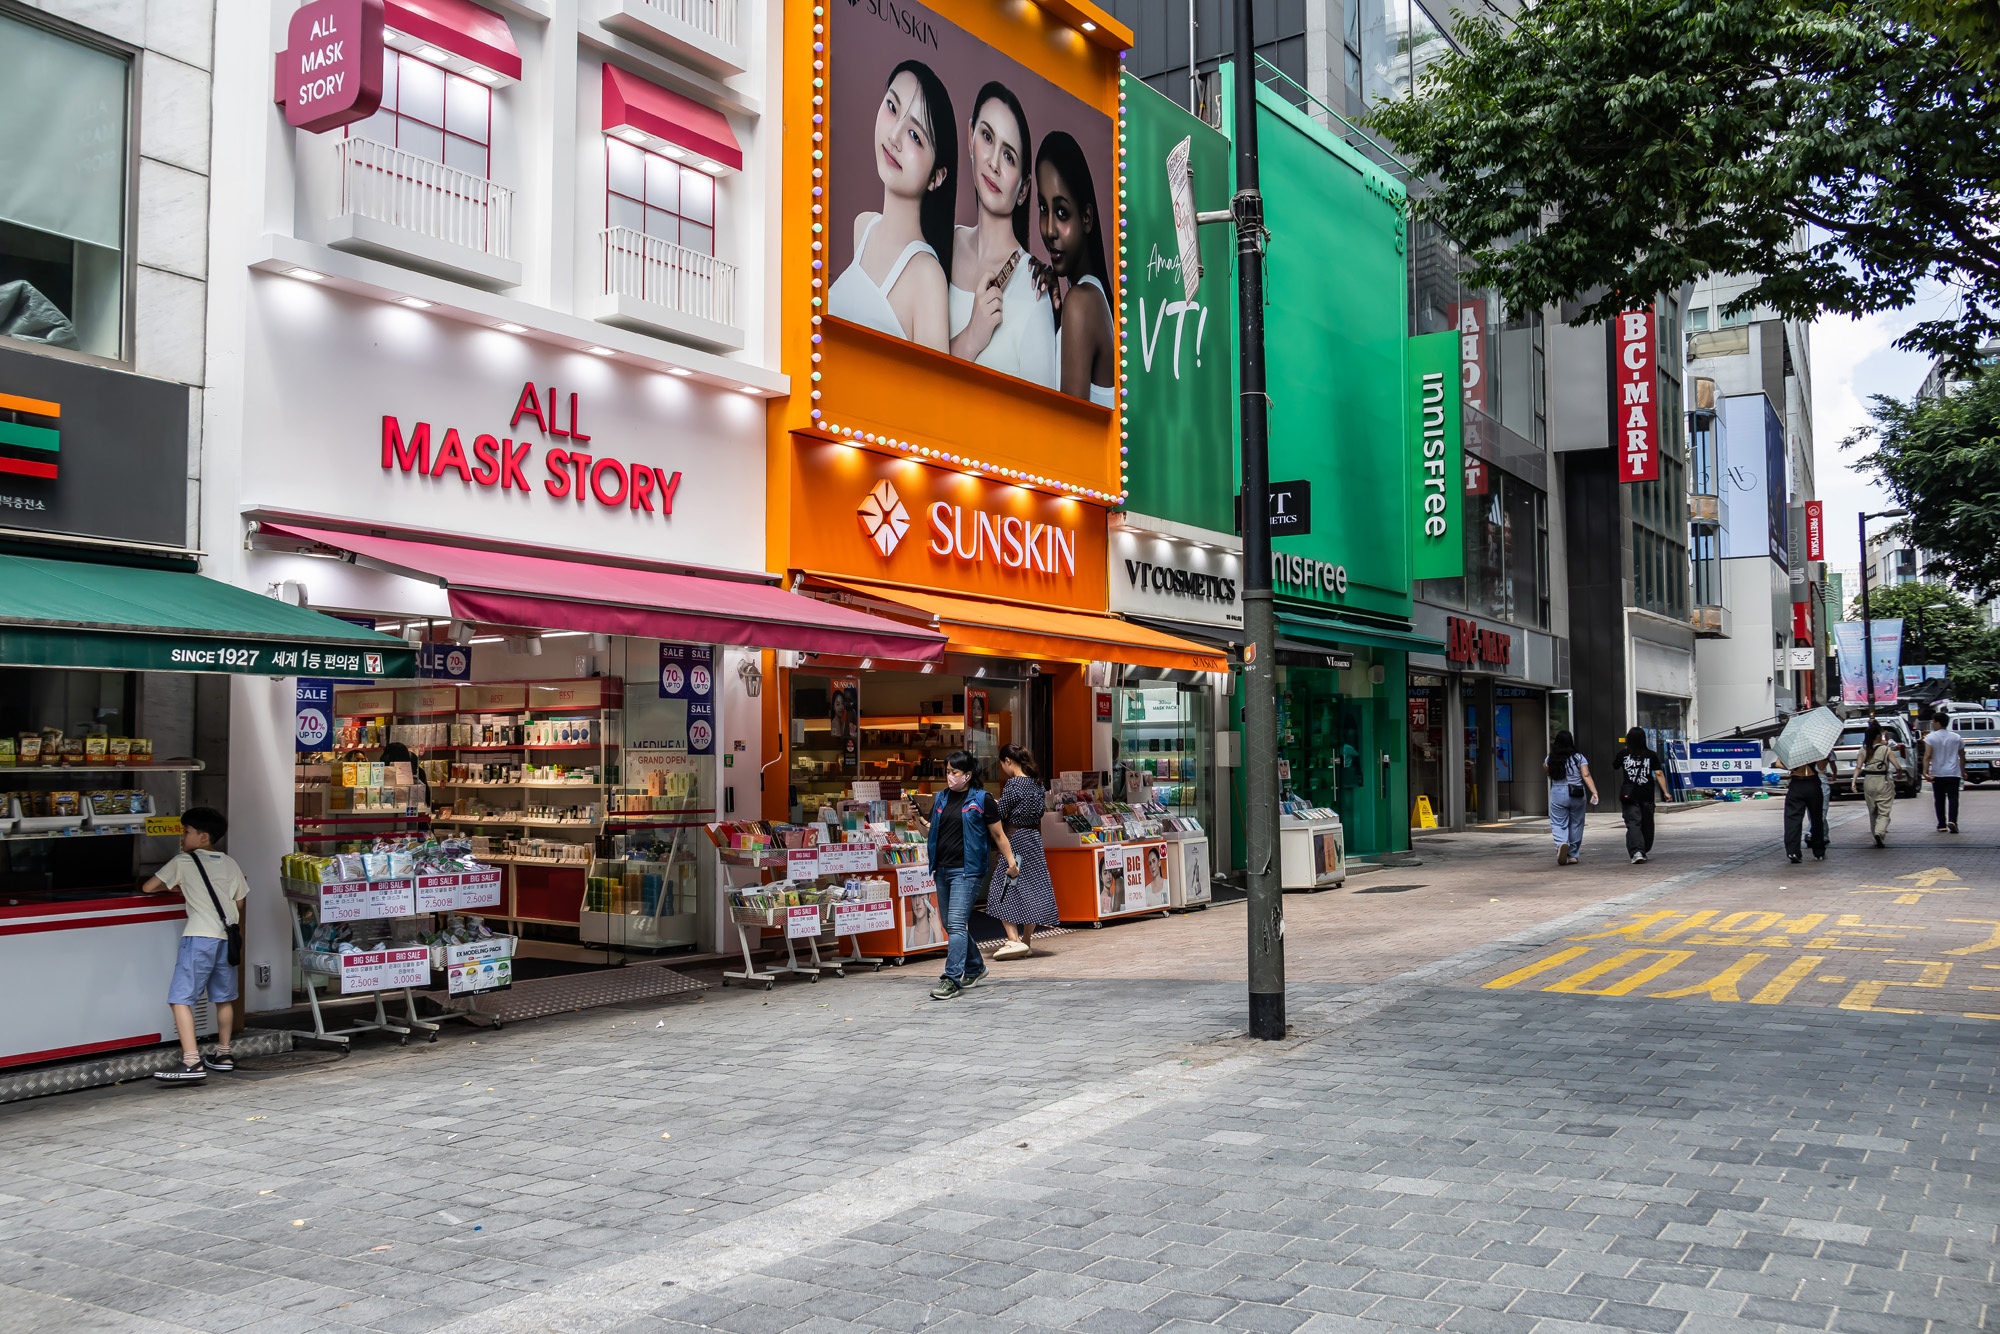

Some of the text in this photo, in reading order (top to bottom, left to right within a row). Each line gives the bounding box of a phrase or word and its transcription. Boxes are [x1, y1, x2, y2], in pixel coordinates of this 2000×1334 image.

[310, 14, 337, 41] ALL
[867, 0, 938, 51] SUNSKIN
[301, 46, 344, 74] MASK
[299, 72, 345, 105] STORY
[1139, 296, 1208, 380] VT!
[510, 381, 591, 441] ALL
[381, 415, 682, 515] MASK STORY
[1270, 515, 1298, 524] ETICS
[927, 501, 1075, 577] SUNSKIN
[1125, 559, 1236, 600] VT COSMETICS
[663, 648, 684, 657] SALE
[691, 649, 710, 659] SALE
[171, 648, 359, 671] SINCE 1927 세계 1등 편의점
[1192, 656, 1218, 669] SUNSKIN
[665, 669, 682, 682] 70%
[693, 671, 709, 683] 70%
[297, 689, 327, 699] SALE
[490, 694, 504, 703] BEST
[559, 691, 575, 700] BEST
[691, 705, 711, 713] SALE
[299, 716, 325, 730] 70%
[1413, 714, 1425, 724] 70
[692, 726, 710, 738] 70%
[637, 756, 686, 764] GRAND OPEN
[1700, 760, 1752, 770] 안전 제일
[1126, 856, 1141, 872] BIG
[440, 877, 453, 885] SALE
[1127, 873, 1143, 886] SALE
[345, 884, 358, 892] SALE
[396, 951, 420, 960] BIG SALE
[463, 948, 488, 956] MODELING
[353, 955, 379, 964] BIG SALE
